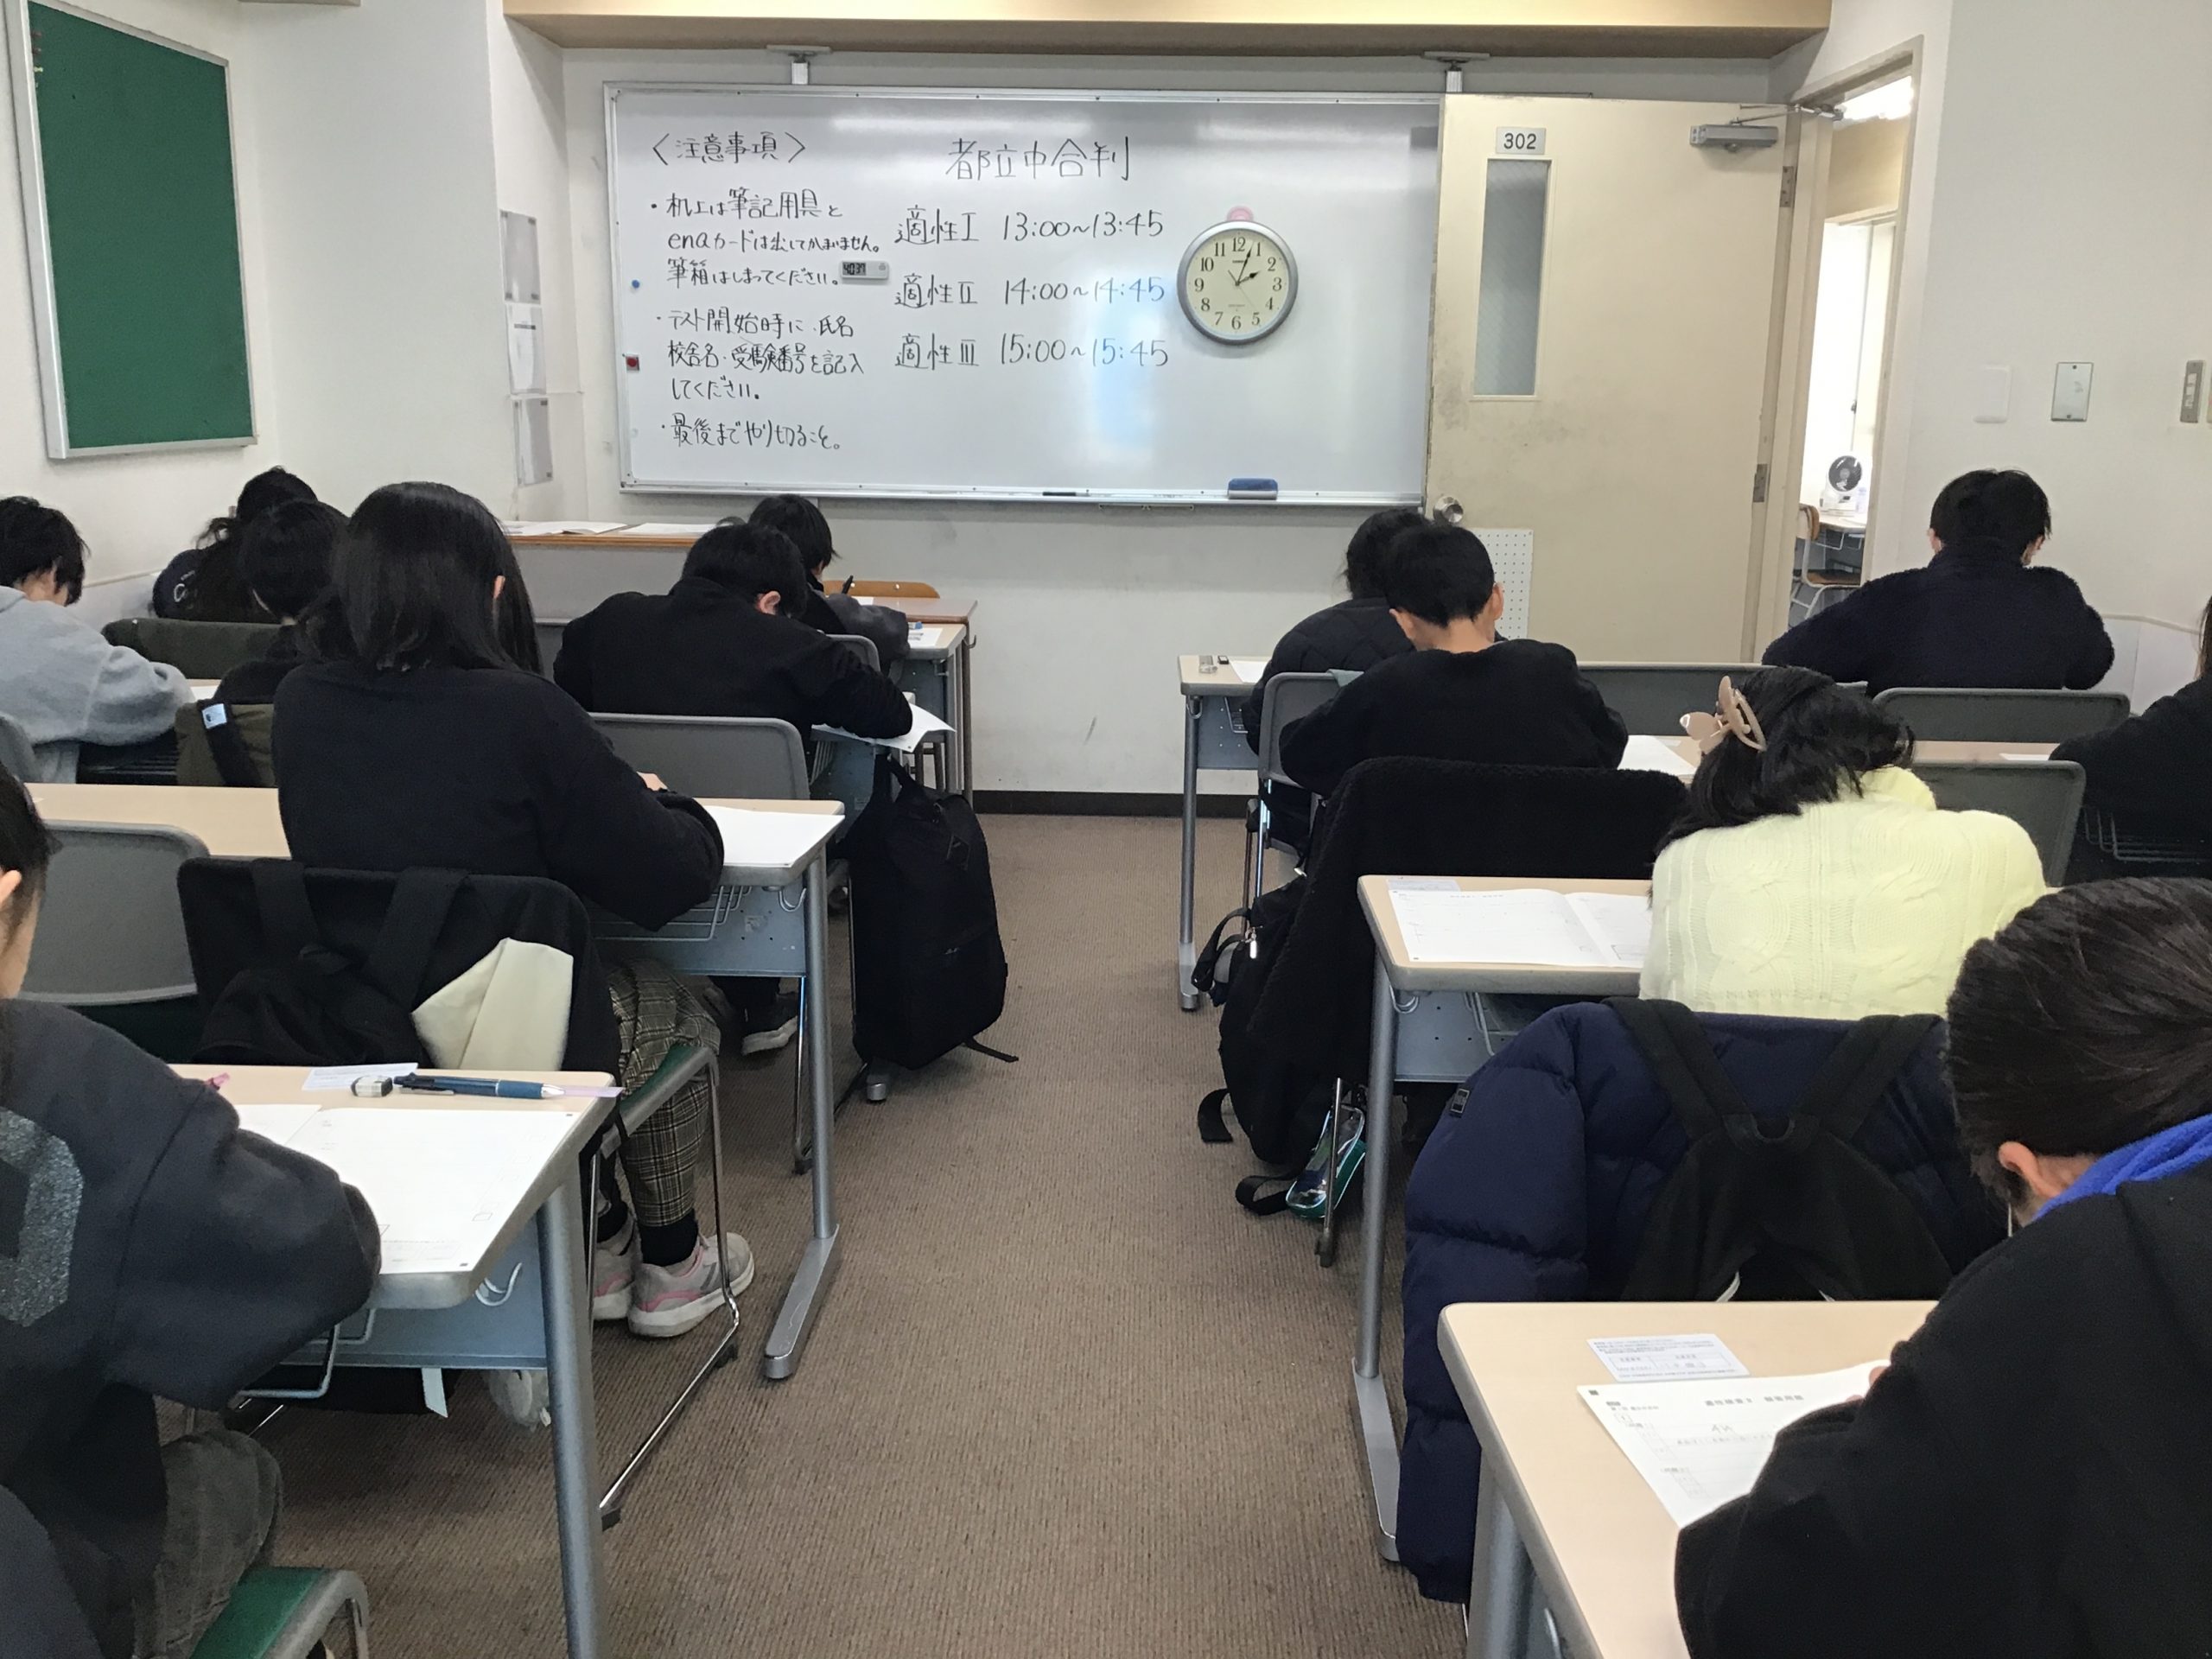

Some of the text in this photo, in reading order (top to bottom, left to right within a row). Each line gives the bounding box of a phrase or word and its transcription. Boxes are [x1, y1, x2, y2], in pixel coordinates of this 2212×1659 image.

[1503, 133, 1536, 149] 302
[945, 136, 1129, 181] 都立中合判
[1215, 242, 1225, 257] 11
[1232, 237, 1245, 252] 12
[1255, 242, 1262, 257] 1
[1201, 257, 1214, 271] 10
[1268, 257, 1276, 271] 2
[1194, 277, 1205, 292] 9
[1272, 276, 1282, 291] 3
[1201, 297, 1211, 311] 8
[1265, 297, 1274, 310] 4
[1215, 312, 1224, 326] 7
[1231, 315, 1242, 330] 6
[1251, 312, 1260, 326] 5
